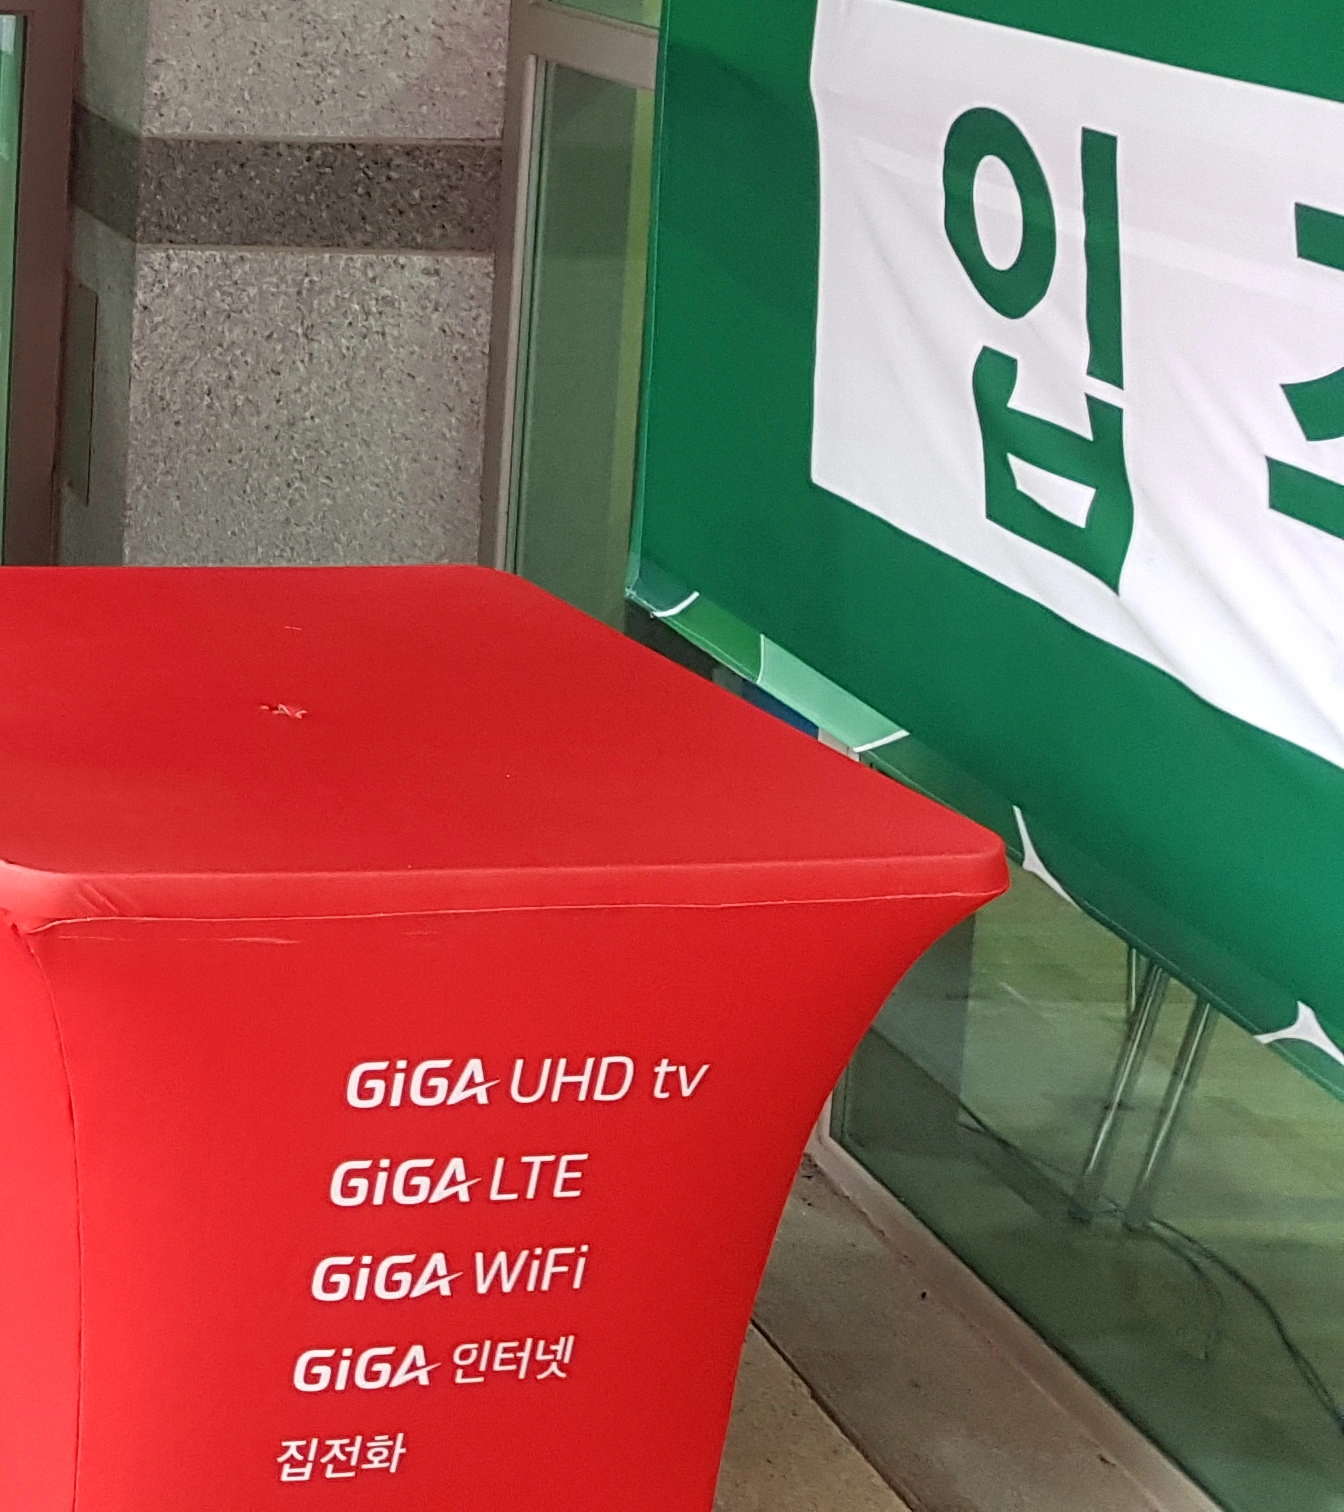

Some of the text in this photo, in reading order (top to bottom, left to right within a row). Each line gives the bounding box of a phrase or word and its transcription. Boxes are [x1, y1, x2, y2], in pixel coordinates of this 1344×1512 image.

[346, 1055, 710, 1109] GiGA UHD tv
[330, 1153, 589, 1207] GiGA LTE
[311, 1244, 589, 1302] GiGA WiFi
[293, 1334, 575, 1392] GiGA 인터넷
[275, 1432, 407, 1483] 집전화
